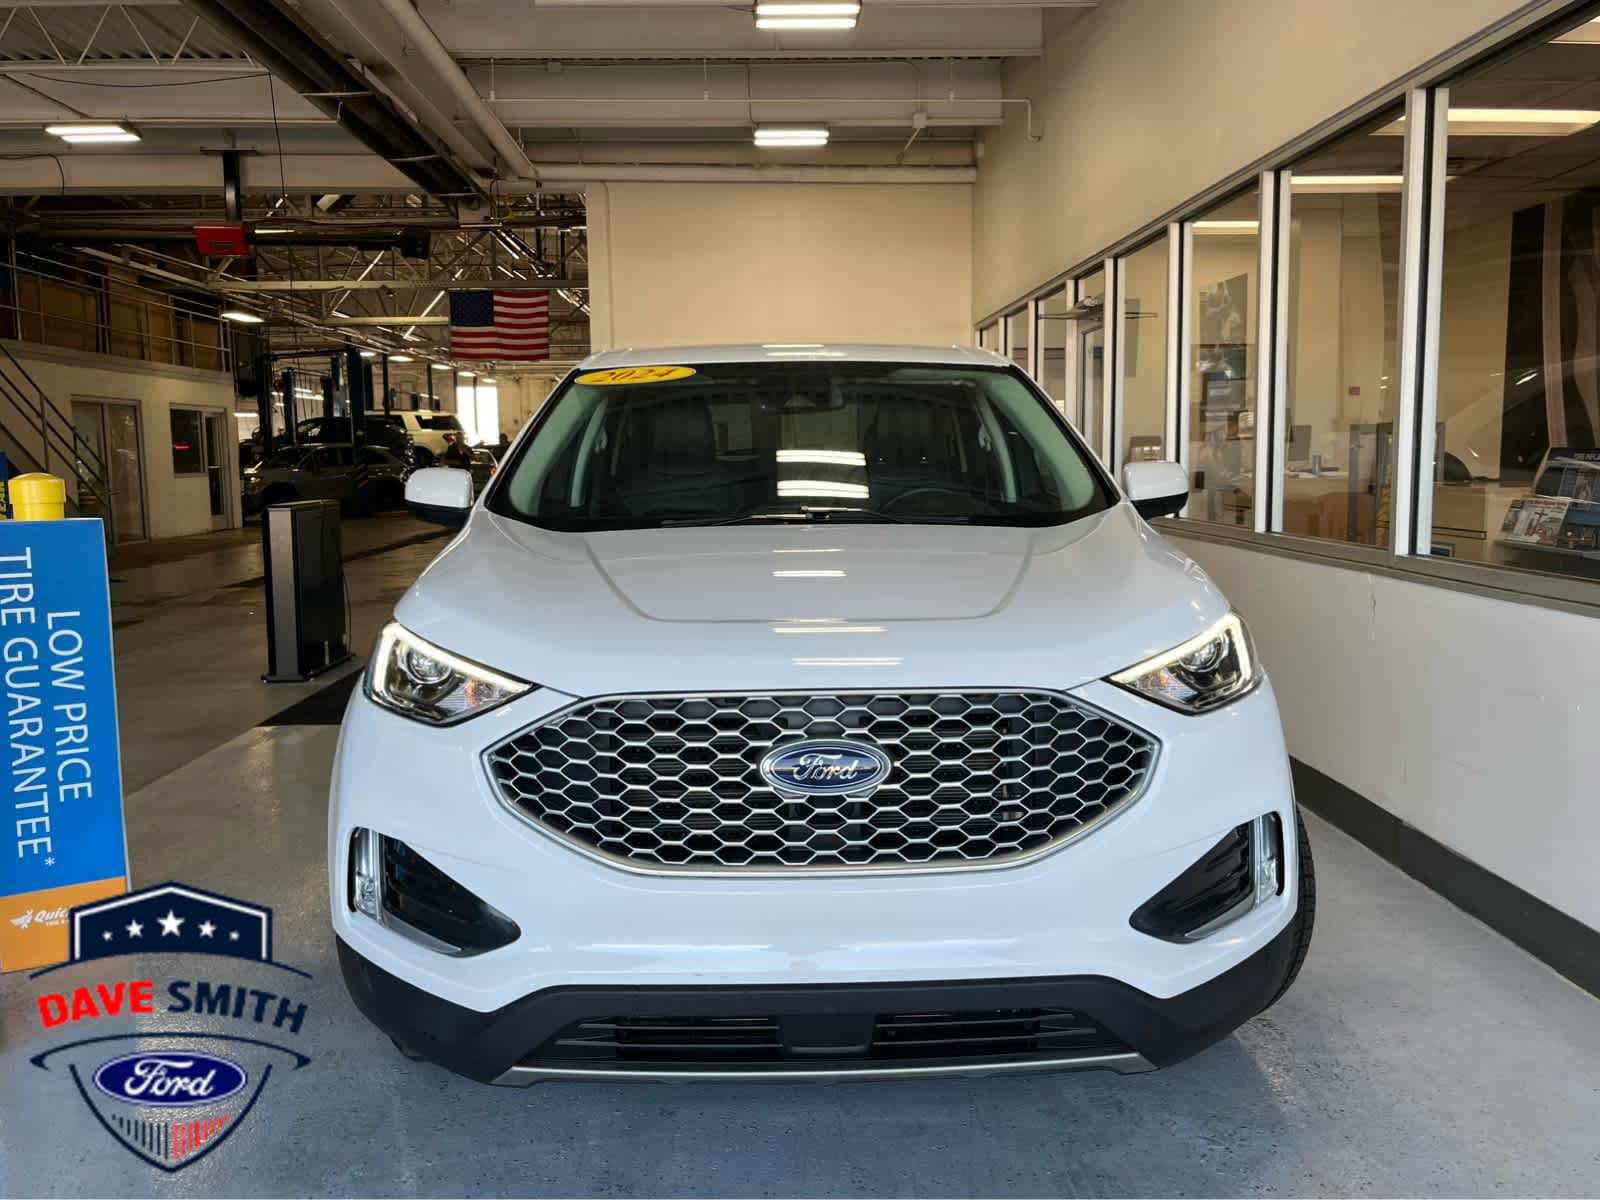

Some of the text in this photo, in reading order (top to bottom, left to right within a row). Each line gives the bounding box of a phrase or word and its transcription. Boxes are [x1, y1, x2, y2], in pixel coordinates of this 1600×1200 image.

[590, 367, 678, 383] 2024
[0, 547, 36, 626] TIRE
[47, 610, 93, 802] LOW PRICE
[792, 752, 859, 781] Ford
[34, 906, 69, 923] Quic
